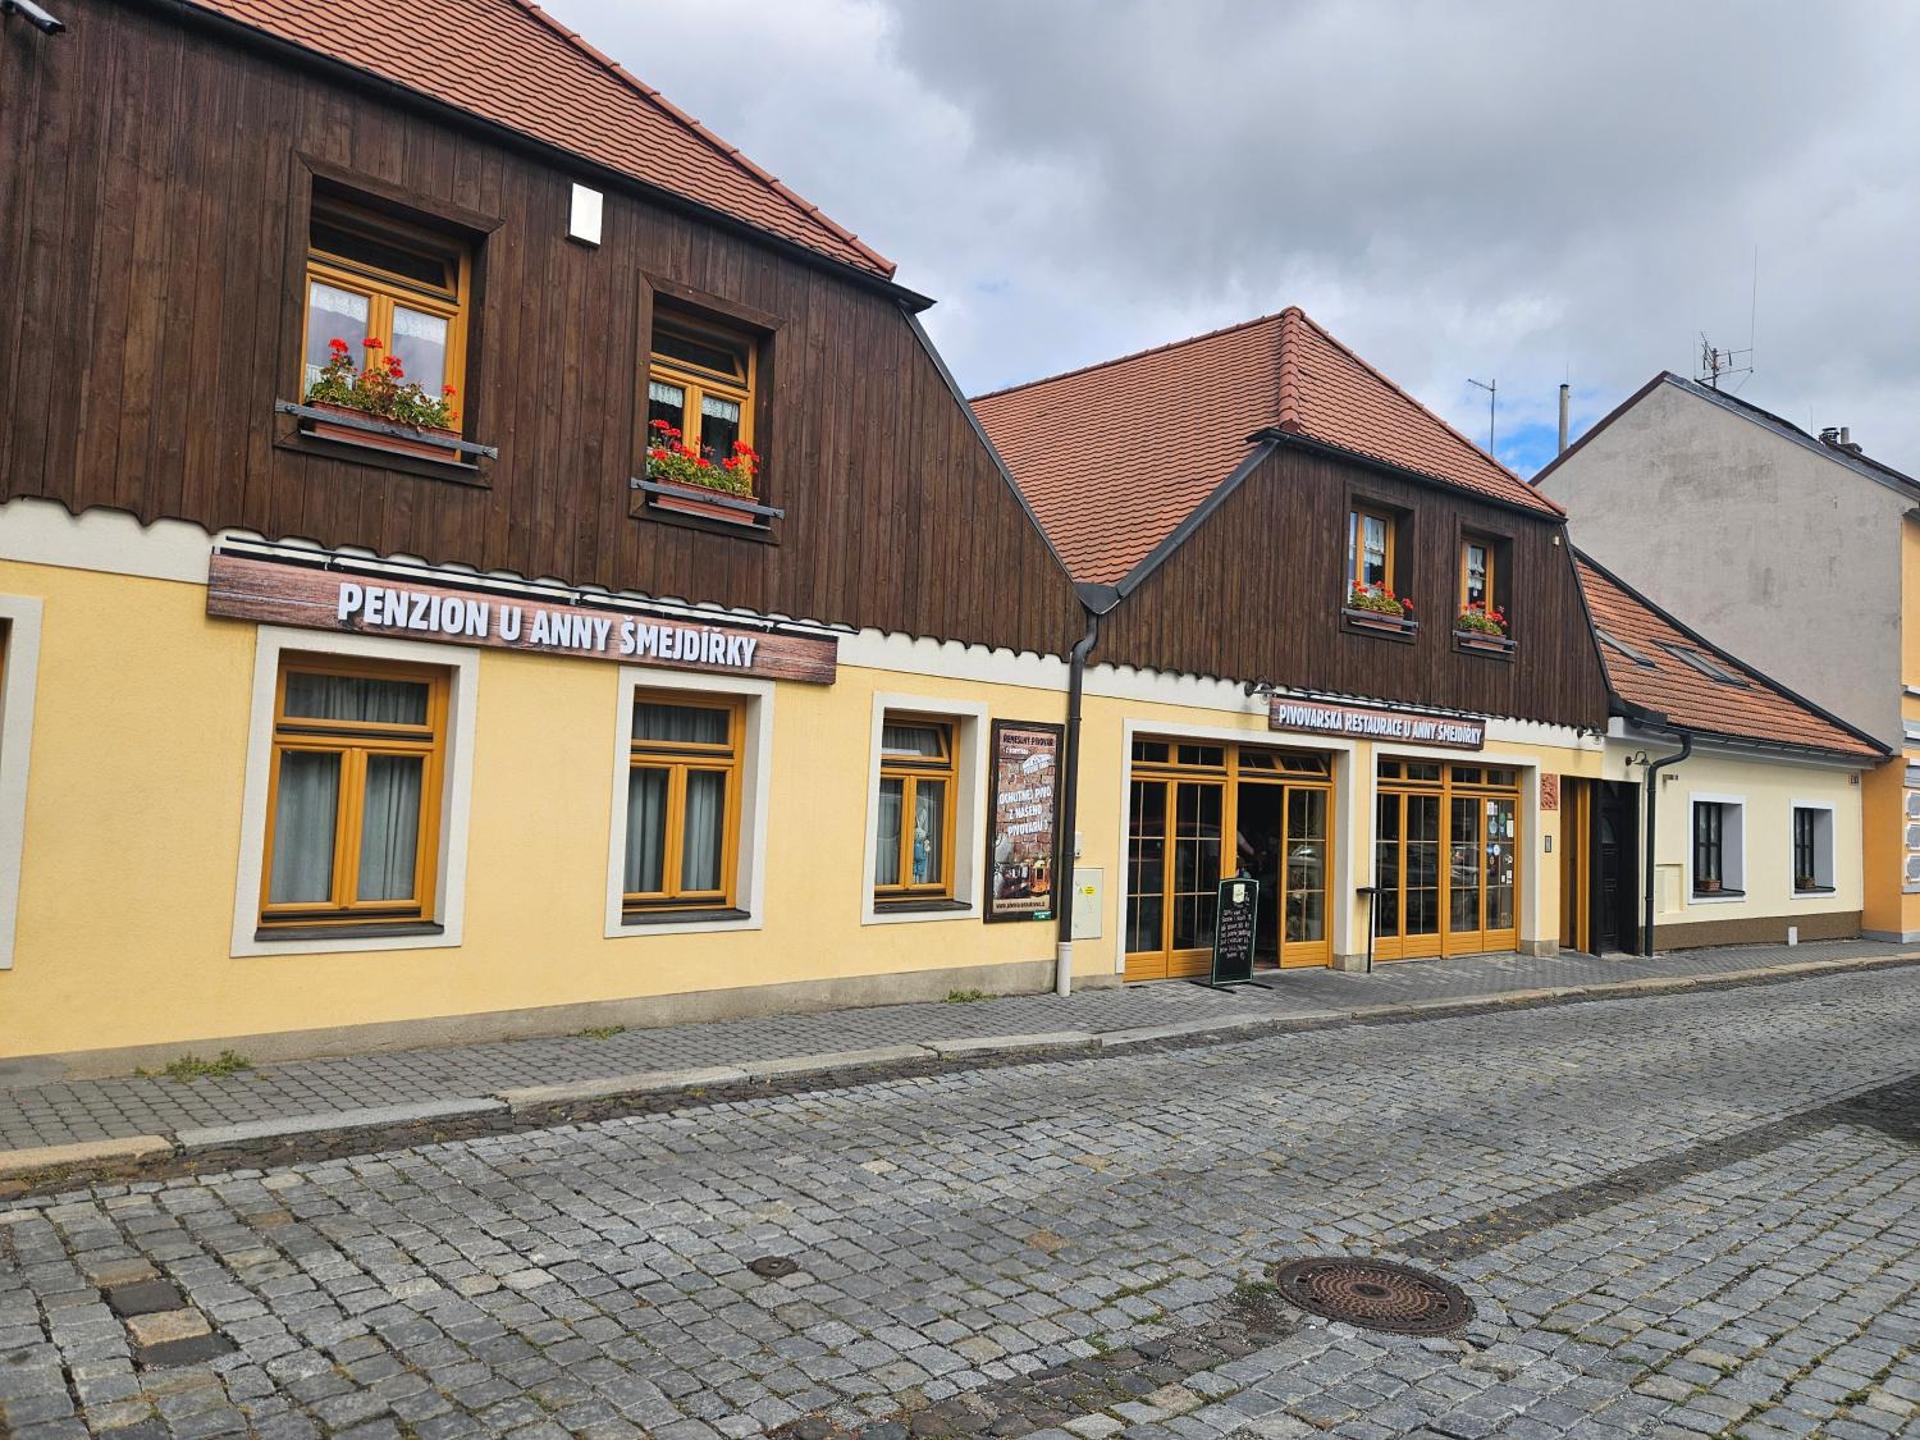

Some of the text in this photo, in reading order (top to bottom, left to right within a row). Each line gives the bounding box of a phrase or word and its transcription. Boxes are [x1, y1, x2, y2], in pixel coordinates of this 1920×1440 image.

[338, 582, 757, 667] PENZION U ANNY ŠMEJDÍŘKY
[1279, 704, 1481, 744] PIVOVARSKÁ RESTAURACE U ANNY ŠMEJDÍŘKY
